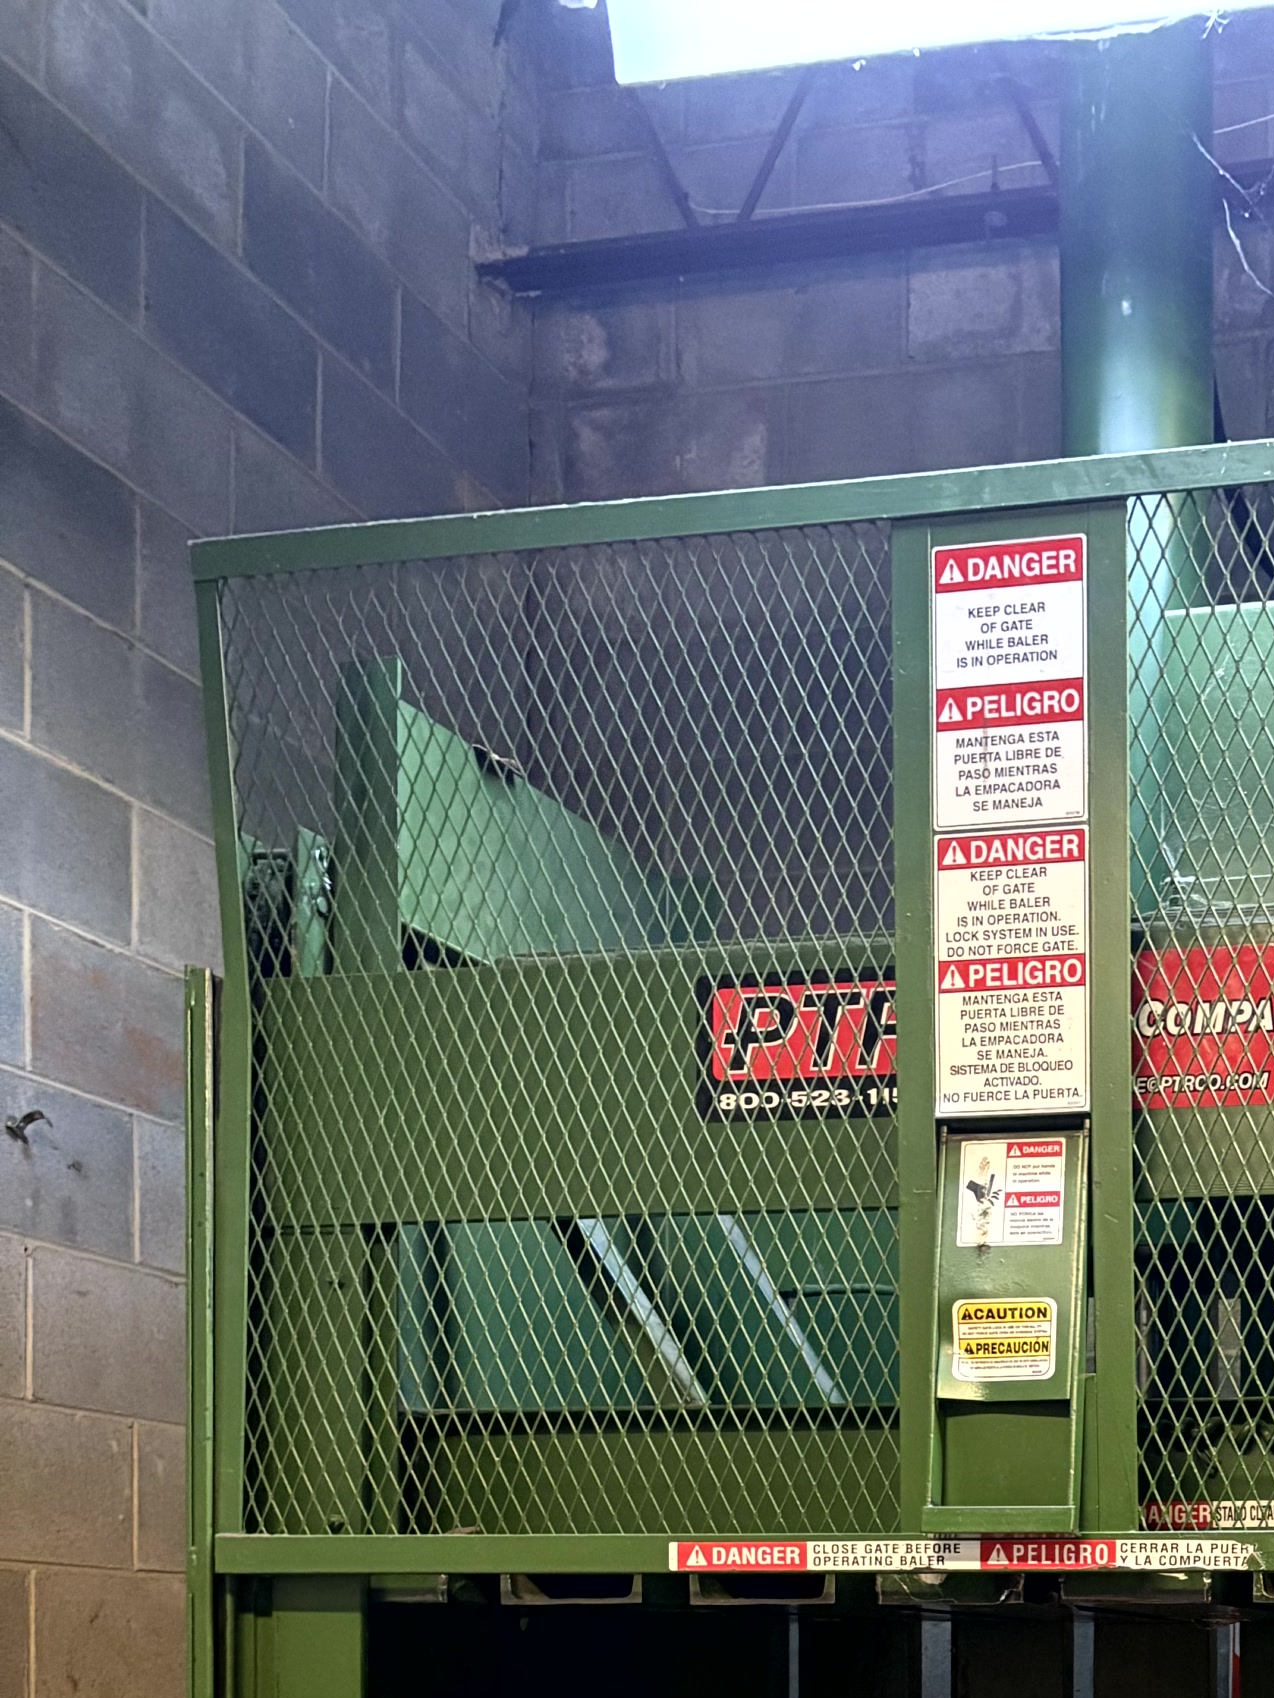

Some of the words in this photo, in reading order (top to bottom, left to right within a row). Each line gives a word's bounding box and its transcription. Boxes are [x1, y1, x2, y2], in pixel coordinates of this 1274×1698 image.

[968, 550, 1076, 582] DANGER
[968, 606, 1000, 618] KEEP
[1004, 602, 1045, 616] CLEAR
[980, 622, 996, 634] OF
[1000, 620, 1032, 632] GATE
[966, 638, 1004, 652] WHILE
[1008, 634, 1048, 648] BALER
[956, 658, 968, 668] IS
[972, 656, 983, 667] IN
[986, 650, 1057, 666] OPERATION
[967, 689, 1079, 720] PELIGRO
[956, 734, 1024, 748] MANTENGA
[1029, 731, 1059, 744] ESTA
[954, 751, 1001, 765] PUERTA
[1006, 749, 1042, 761] LIBRE
[1046, 747, 1061, 758] DE
[958, 768, 990, 780] PASO
[994, 764, 1057, 778] MIENTRAS
[956, 786, 971, 797] LA
[975, 780, 1060, 795] EMPACADORA
[973, 801, 989, 812] SE
[993, 798, 1042, 810] MANEJA
[970, 834, 1079, 863] DANGER
[946, 930, 978, 942] LOCK
[983, 928, 1032, 941] SYSTEM
[1036, 928, 1048, 937] IN
[1052, 924, 1079, 936] USE.
[947, 946, 964, 957] DO
[968, 944, 992, 956] NOT
[997, 942, 1038, 954] FORCE
[1042, 940, 1078, 952] GATE.
[969, 958, 1082, 986] PELIGRO
[1023, 1145, 1060, 1154] DANGER
[1020, 1195, 1058, 1204] PELIGRO
[974, 1307, 1048, 1320] CAUTION
[976, 1337, 1049, 1355] PRECAUCIÓN
[712, 1547, 800, 1564] DANGER
[813, 1544, 858, 1554] CLOSE
[864, 1544, 899, 1554] GATE
[904, 1543, 961, 1554] BEFORE
[1013, 1544, 1108, 1564] PELIGRO
[1120, 1543, 1179, 1553] CERRAR
[1187, 1543, 1204, 1553] LA
[813, 1556, 893, 1566] OPERATING
[900, 1556, 945, 1566] BALER
[1120, 1556, 1127, 1565] Y
[1135, 1556, 1152, 1565] LA
